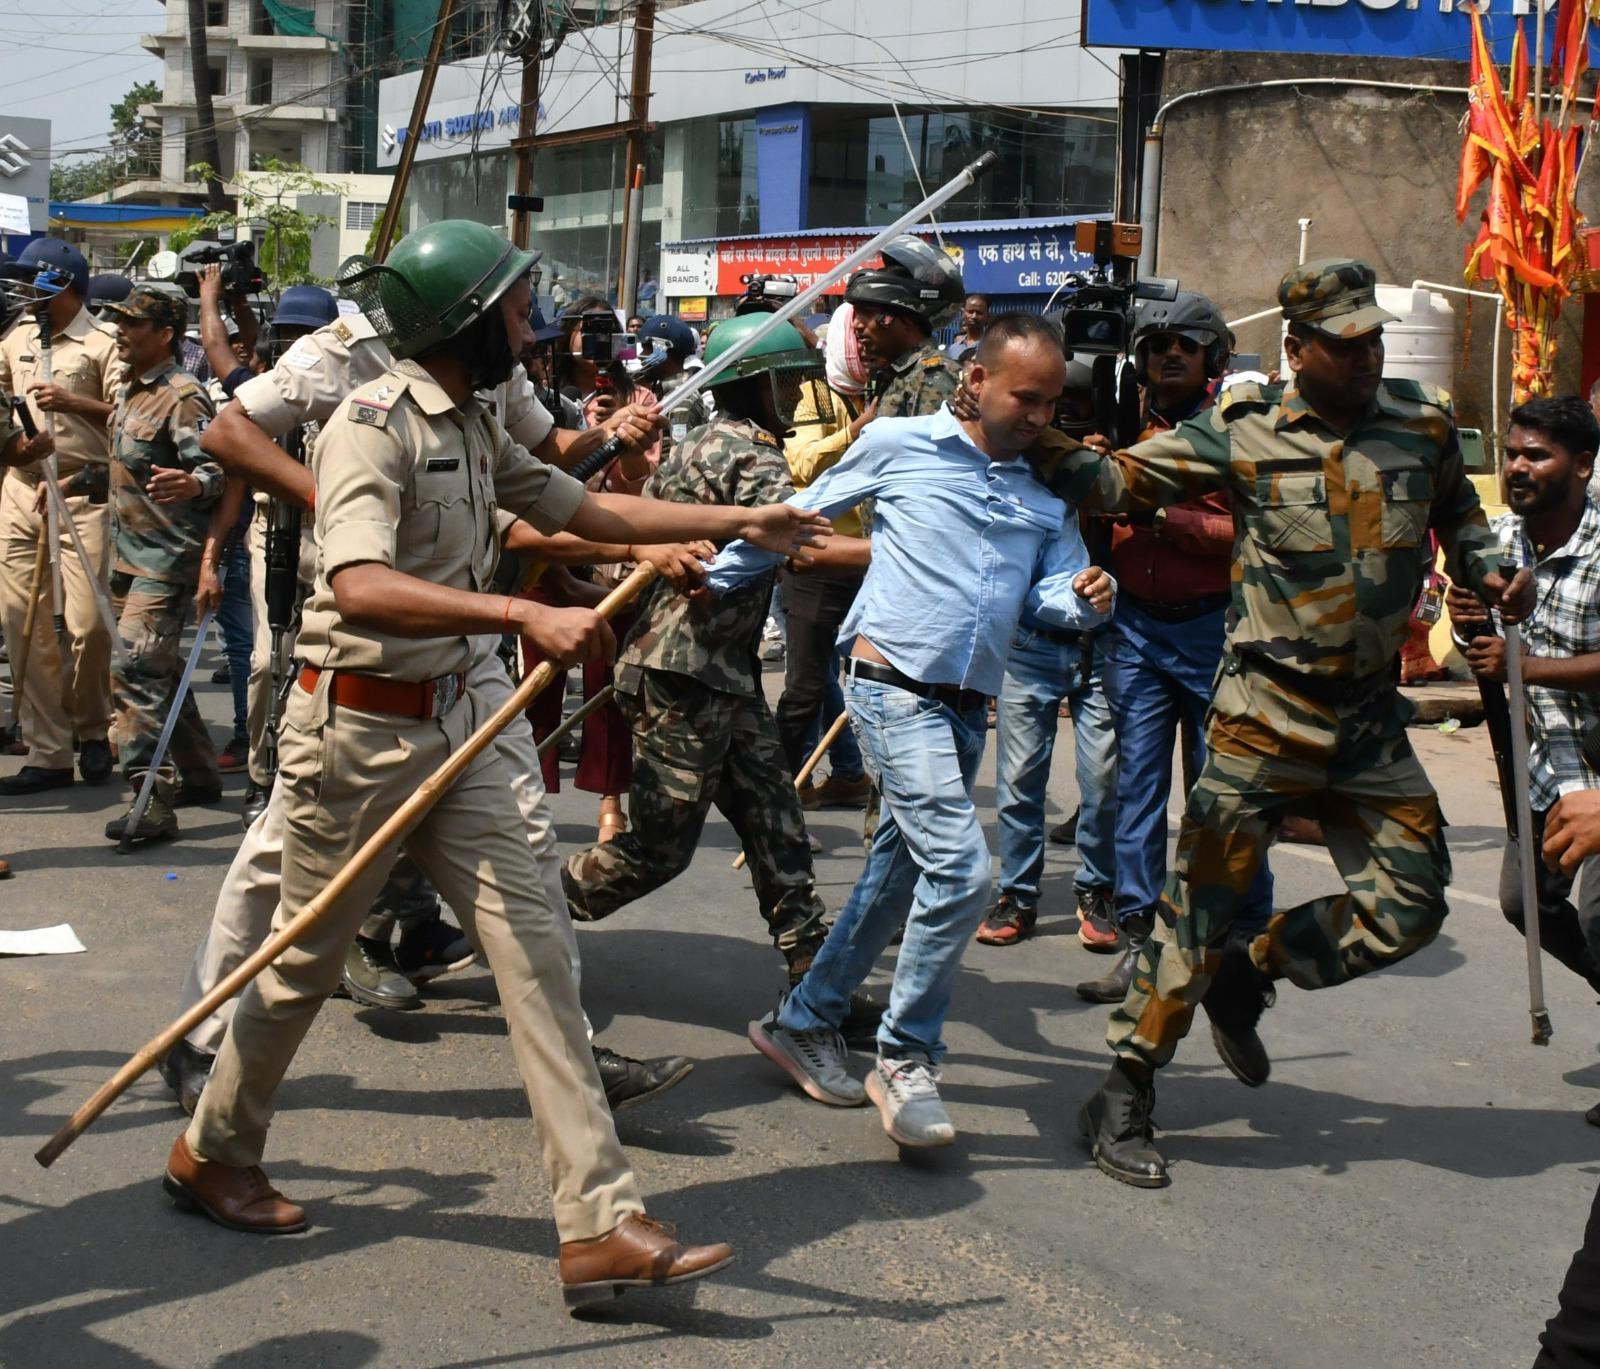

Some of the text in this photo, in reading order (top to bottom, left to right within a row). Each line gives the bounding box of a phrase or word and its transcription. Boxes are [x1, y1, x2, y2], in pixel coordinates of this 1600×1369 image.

[445, 110, 495, 136] SUZUKI
[736, 248, 745, 262] पर
[978, 245, 999, 266] एक
[1003, 243, 1025, 264] हाथ
[1029, 235, 1041, 261] से
[1045, 234, 1064, 264] दो,
[667, 275, 699, 284] BRANDS
[1018, 272, 1041, 287] Call:
